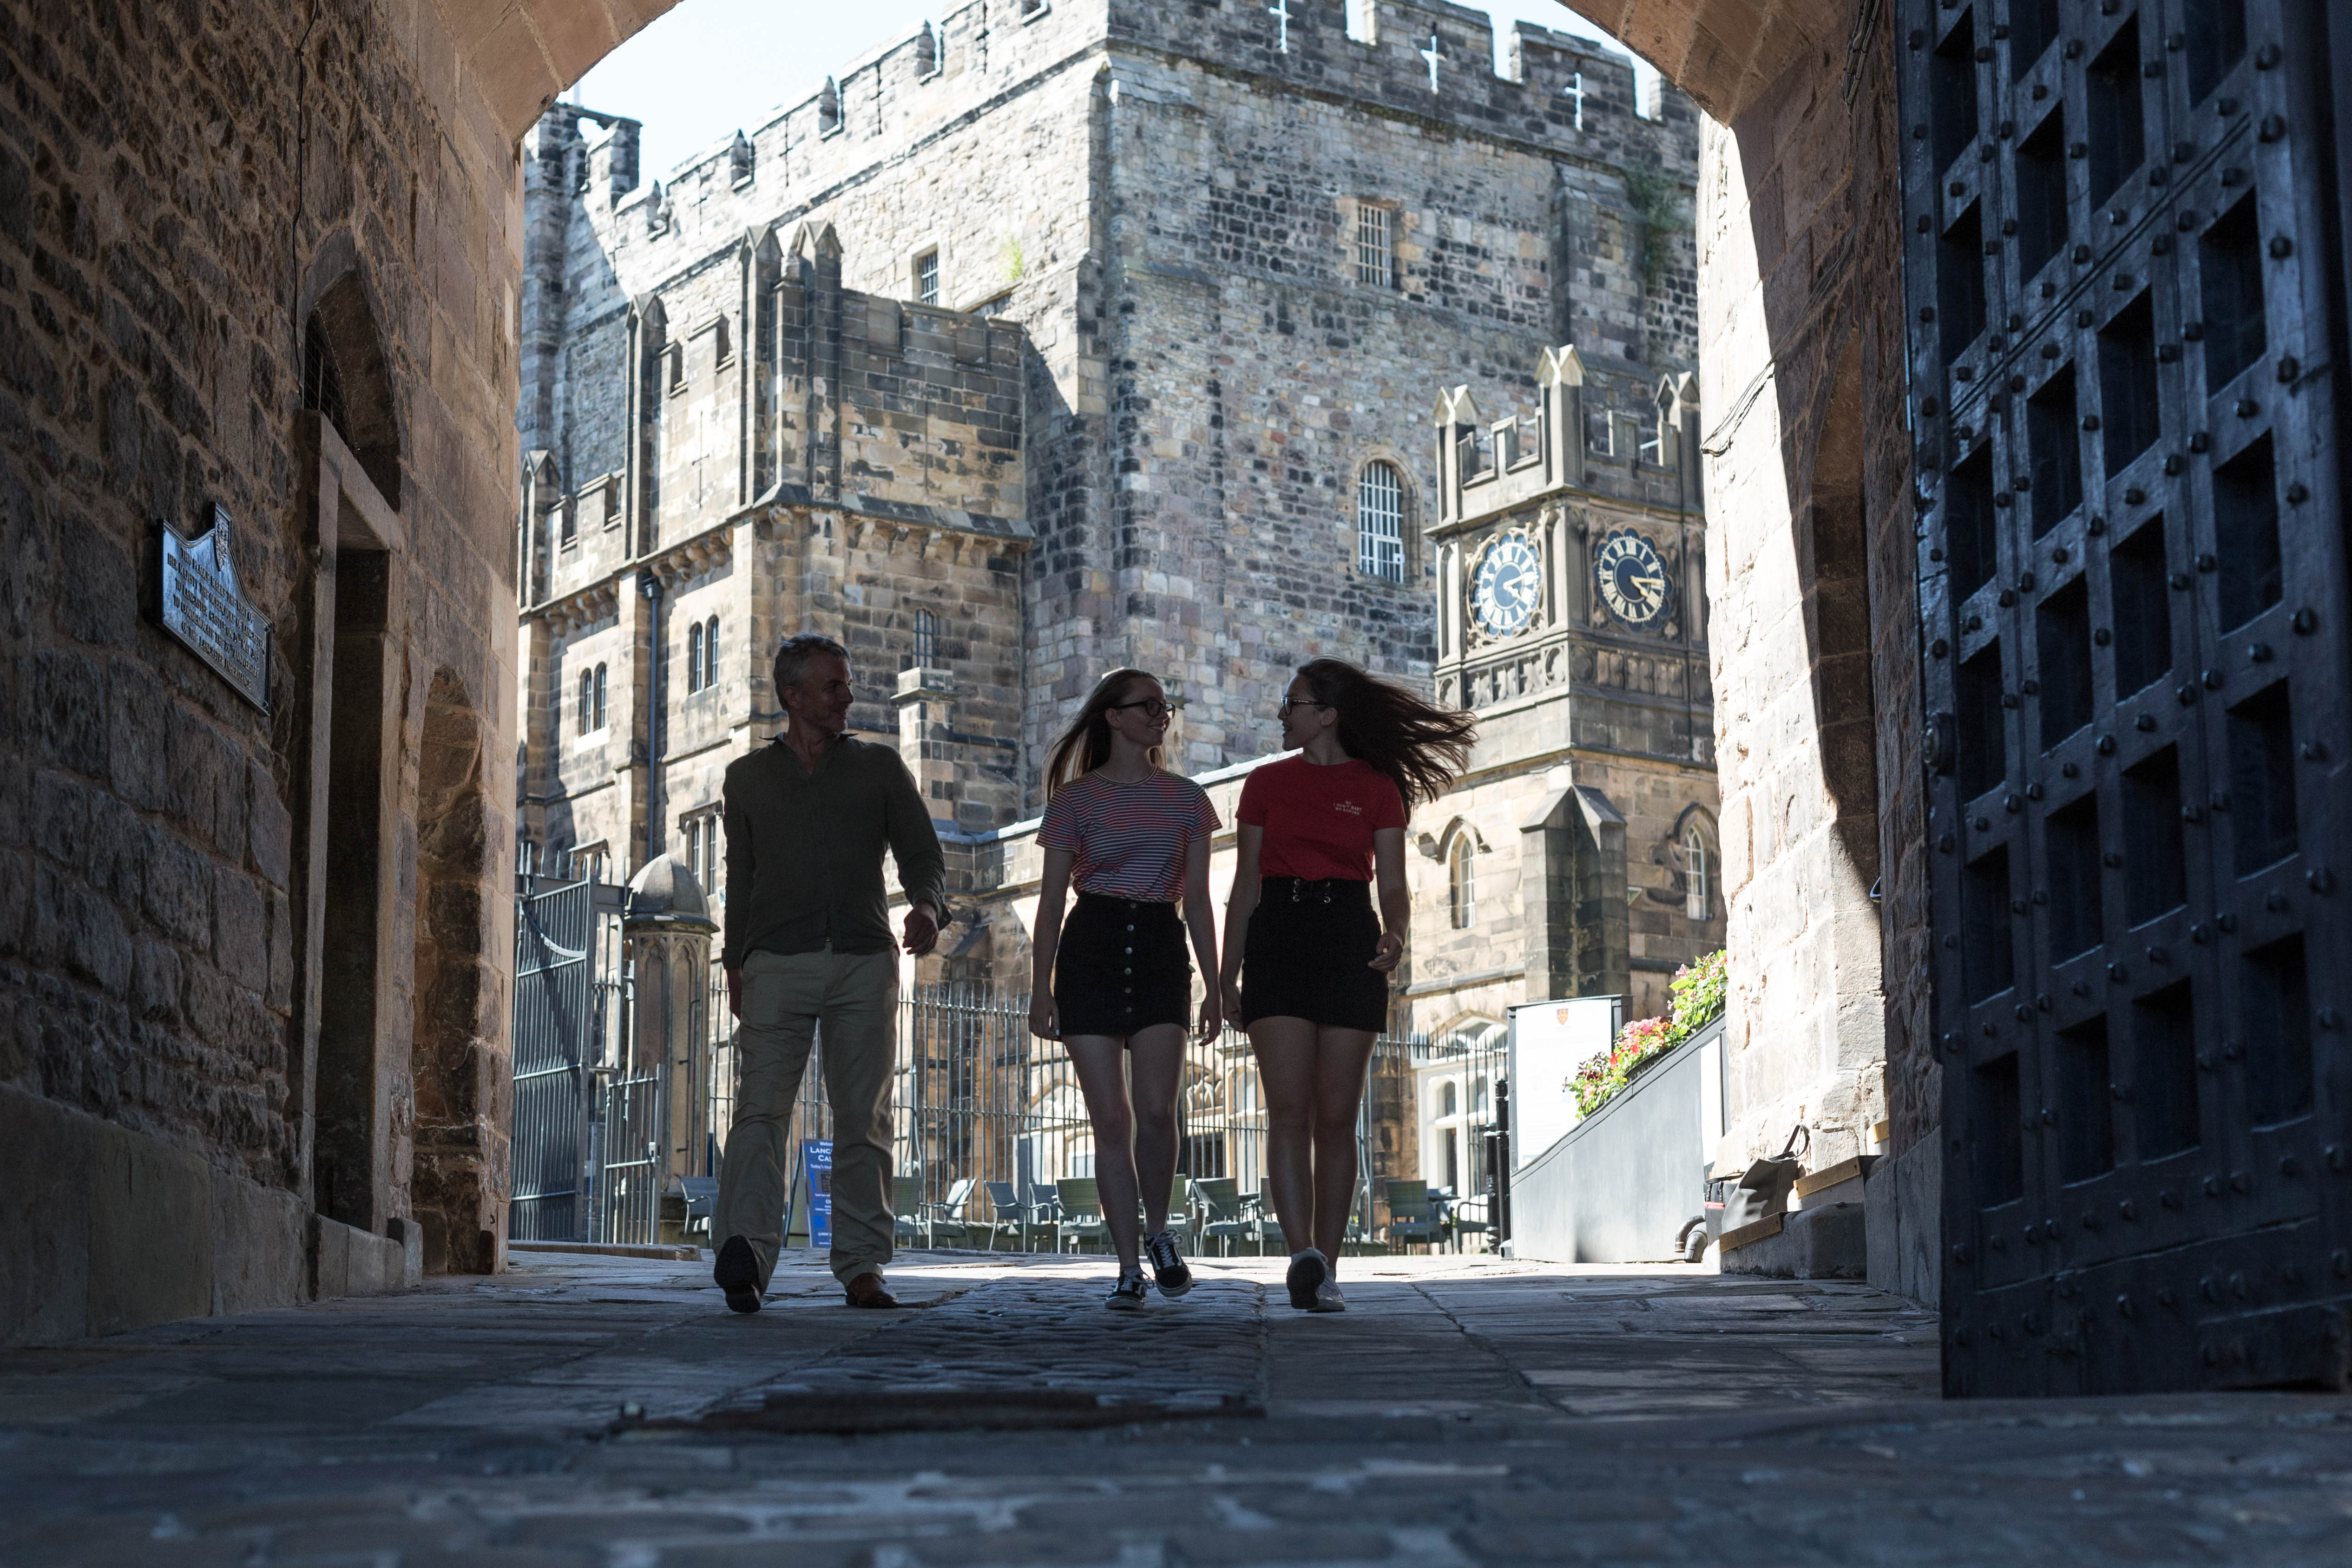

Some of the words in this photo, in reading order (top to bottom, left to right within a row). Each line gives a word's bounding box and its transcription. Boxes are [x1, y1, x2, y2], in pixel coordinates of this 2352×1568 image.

[1626, 540, 1637, 555] XII
[1640, 547, 1647, 561] I
[1604, 552, 1616, 566] X
[1647, 561, 1658, 573] II
[168, 553, 177, 570] HER
[178, 563, 198, 590] MAJESTY
[199, 583, 208, 599] THE
[224, 607, 235, 624] DUKE
[236, 617, 242, 630] OF
[181, 548, 191, 565] THIS
[193, 560, 209, 582] PLAQUE
[210, 576, 225, 597] MARKS
[227, 591, 236, 607] THE
[236, 600, 247, 617] VISIT
[248, 611, 254, 623] OF
[175, 578, 181, 591] TO
[182, 585, 207, 616] LANCASTER
[209, 610, 225, 632] CASTLE
[226, 626, 232, 639] ON
[241, 639, 249, 653] MAY
[1628, 603, 1637, 618] VI
[1641, 603, 1651, 617] V
[173, 595, 179, 607] TO
[181, 602, 214, 639] COMMEMORATE
[215, 632, 224, 648] THE
[233, 648, 259, 679] ANNIVERSARY
[181, 621, 188, 634] OF
[189, 627, 197, 643] THE
[199, 636, 223, 666] LANCASTER
[224, 658, 251, 690] INHERITANCE
